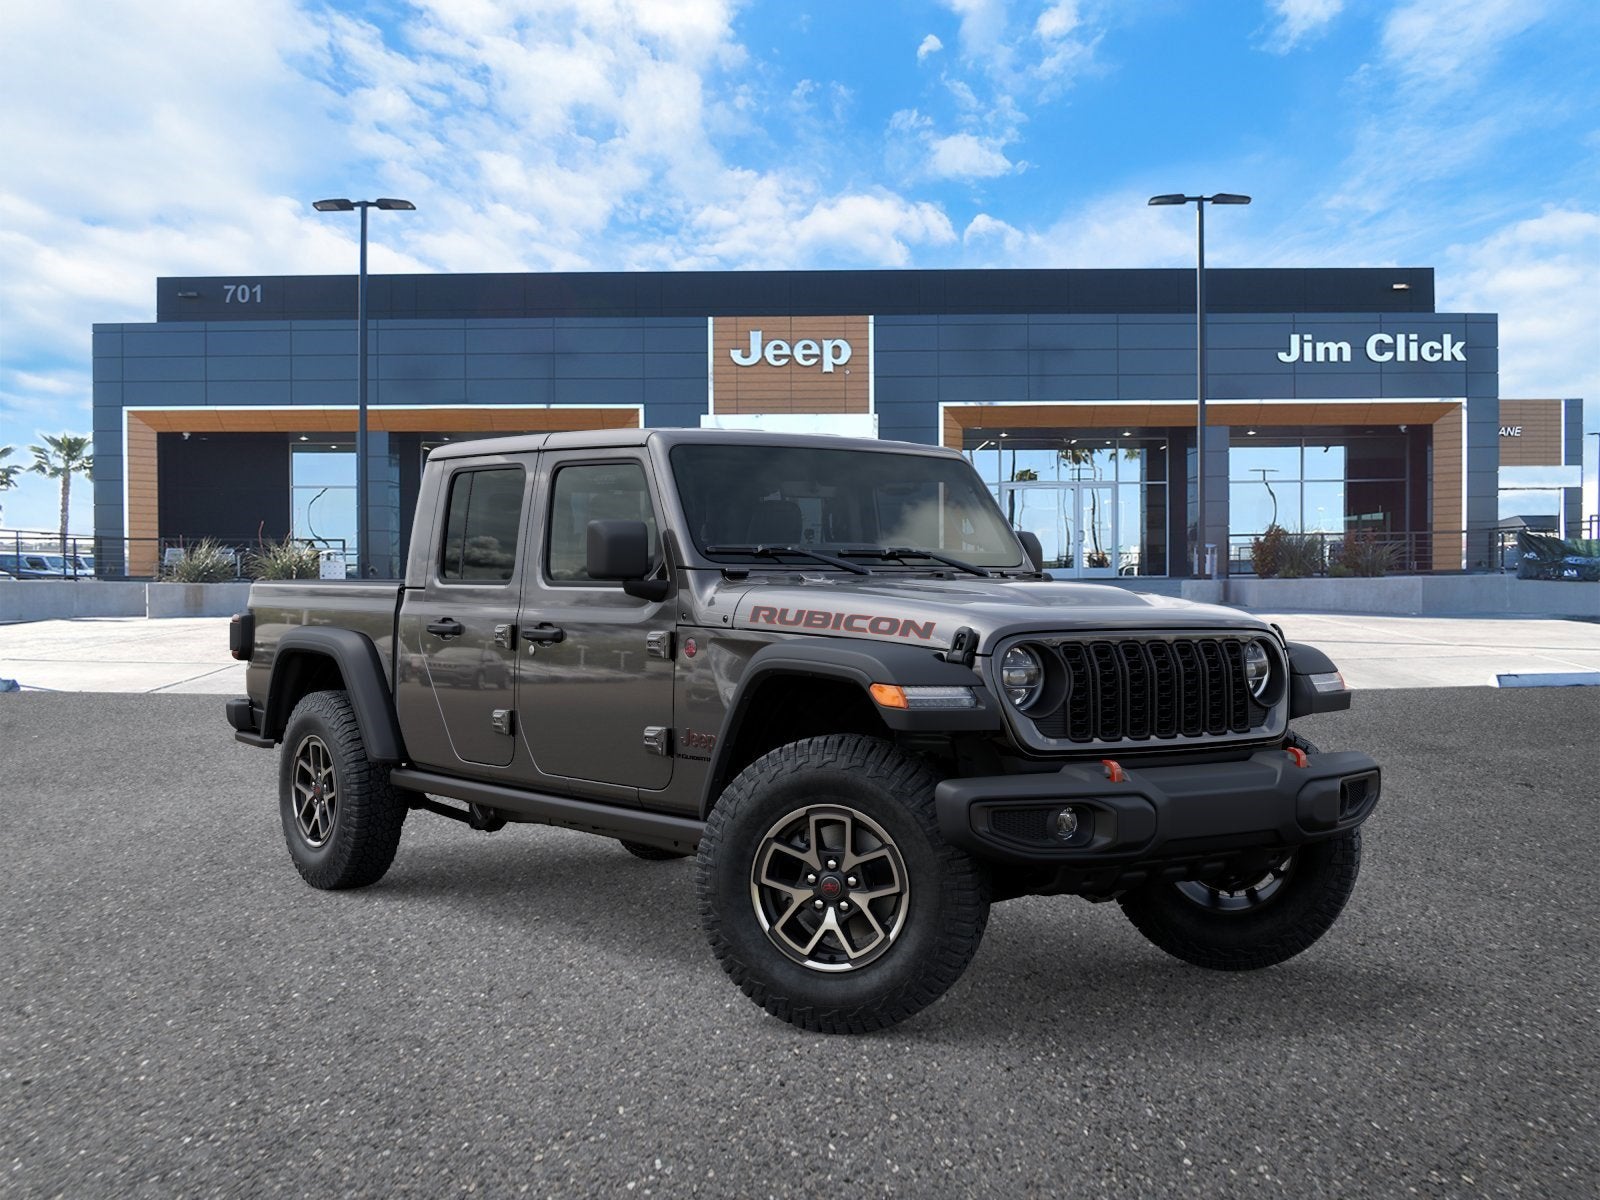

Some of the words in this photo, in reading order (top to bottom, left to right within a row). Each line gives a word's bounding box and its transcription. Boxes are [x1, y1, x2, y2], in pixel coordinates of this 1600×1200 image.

[223, 284, 262, 303] 701
[730, 330, 852, 373] Jeep
[1277, 334, 1351, 362] Jim
[1366, 333, 1467, 362] Click
[750, 606, 936, 640] RUBICON
[680, 728, 717, 753] Jeep
